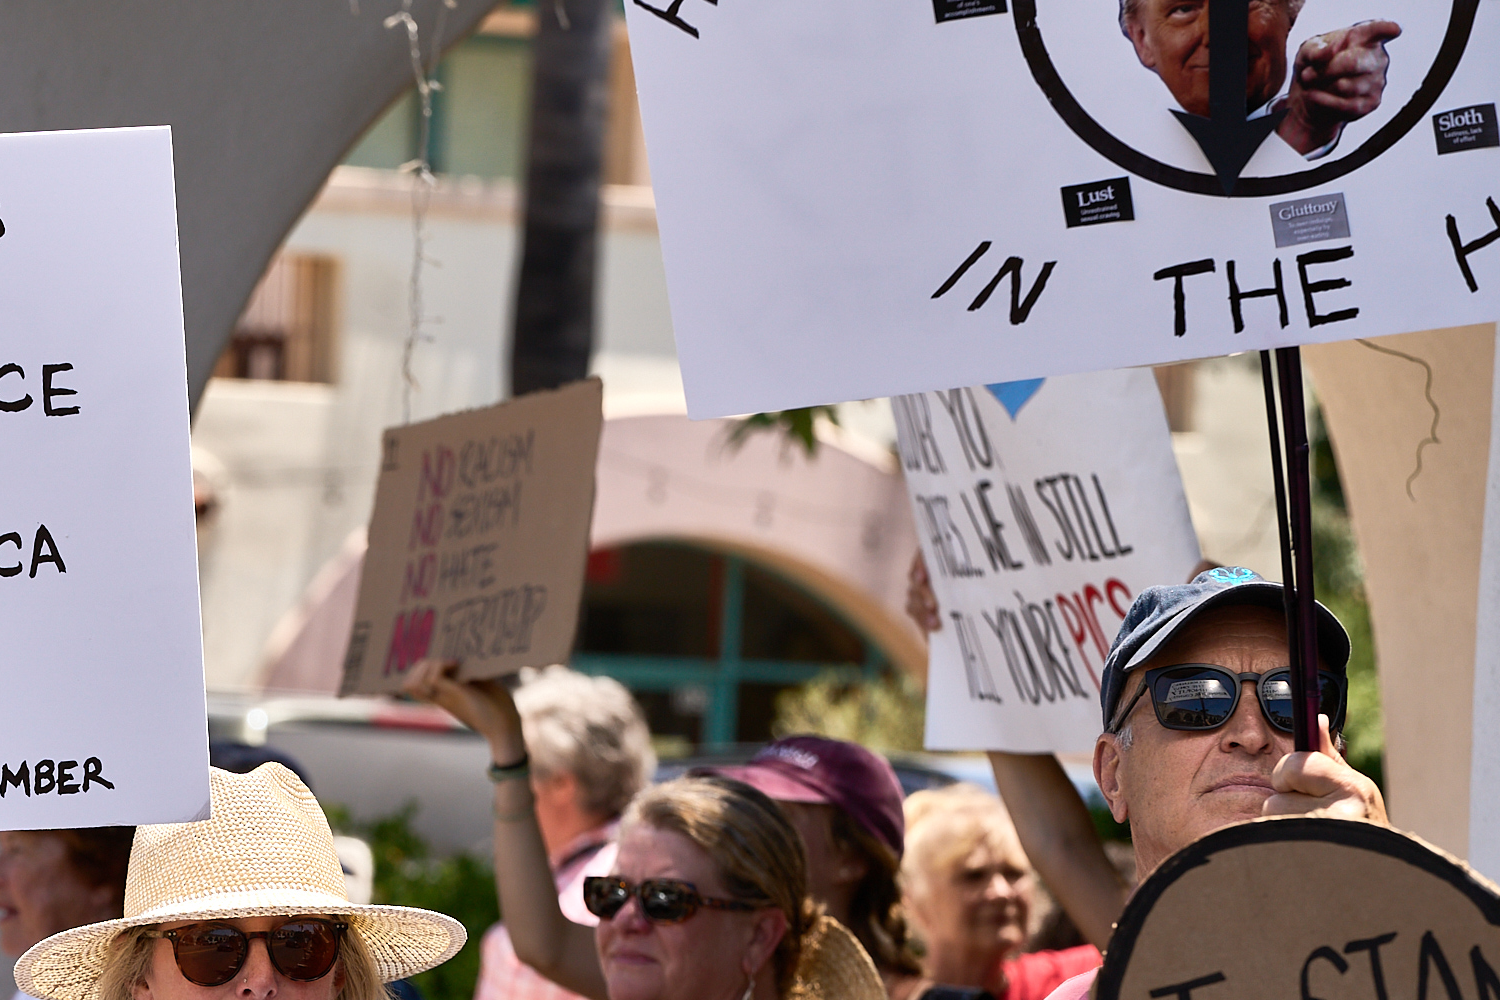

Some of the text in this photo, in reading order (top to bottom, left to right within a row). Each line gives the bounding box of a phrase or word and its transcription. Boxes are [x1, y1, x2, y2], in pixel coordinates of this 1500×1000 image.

[1438, 108, 1484, 131] Sloth
[1077, 185, 1115, 207] Lust
[1278, 200, 1337, 220] Gluttony
[931, 241, 1058, 326] IN
[1153, 245, 1360, 337] THE
[960, 480, 1025, 572] WE
[1033, 473, 1134, 563] STILL
[437, 543, 500, 591] HATE
